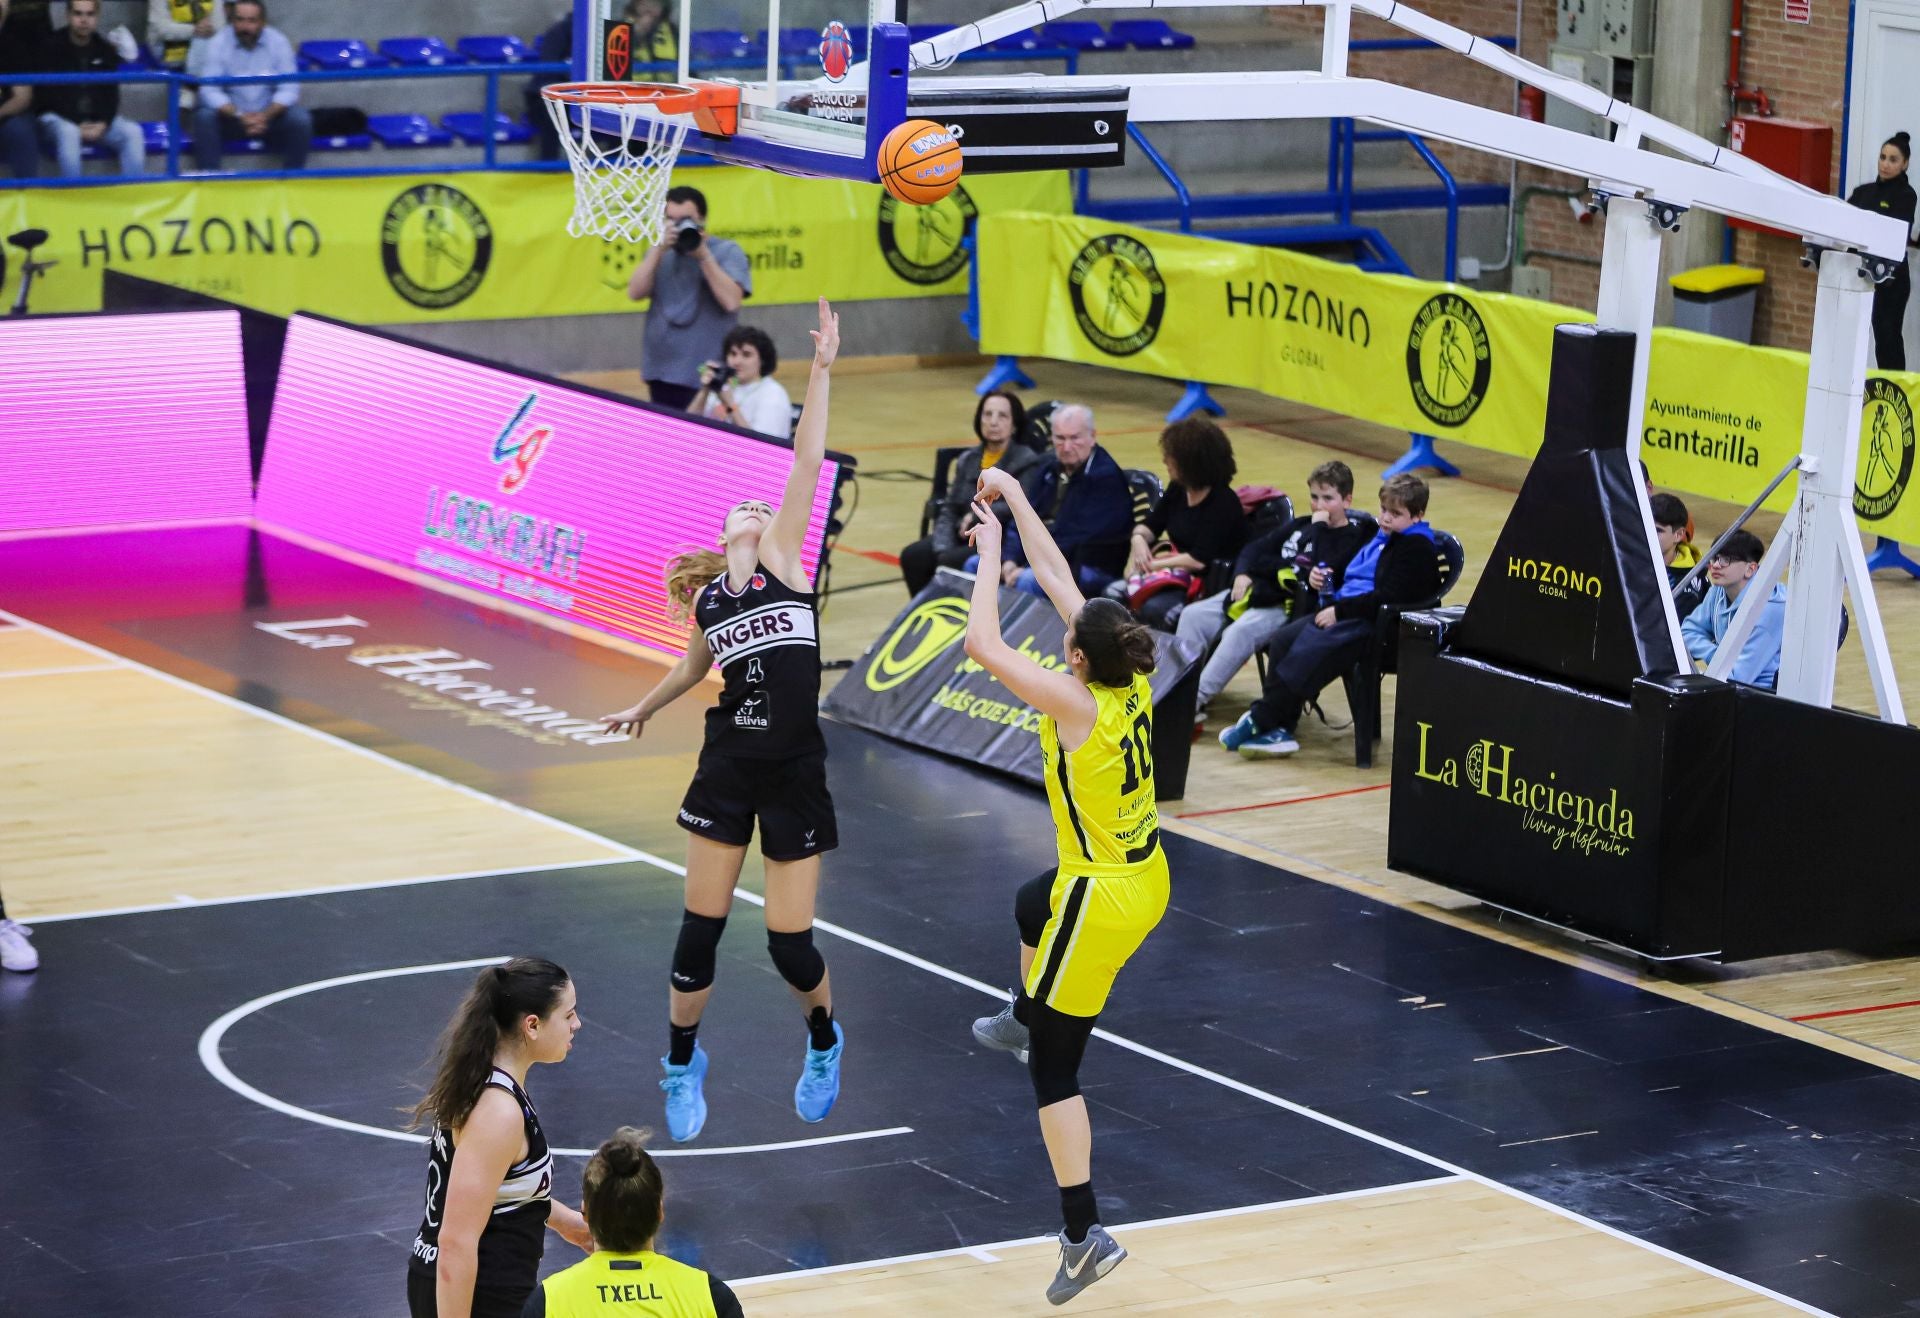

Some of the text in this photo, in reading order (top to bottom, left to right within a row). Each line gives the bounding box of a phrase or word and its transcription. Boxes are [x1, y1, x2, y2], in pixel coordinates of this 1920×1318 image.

[812, 91, 858, 108] EUROCUP
[815, 104, 853, 122] WOMEN
[79, 217, 320, 268] HOZONO
[1226, 281, 1370, 348] HOZONO
[1650, 398, 1762, 431] Ayuntamiento de
[1643, 426, 1760, 468] cantarilla
[1507, 556, 1602, 598] HOZONO
[1538, 584, 1568, 600] GLOBAL
[709, 611, 794, 656] ANGERS
[746, 657, 764, 683] 4
[734, 715, 768, 727] Elivia
[1120, 710, 1151, 797] 10
[1415, 721, 1635, 839] La Hacienda
[596, 1283, 663, 1303] TXELL
